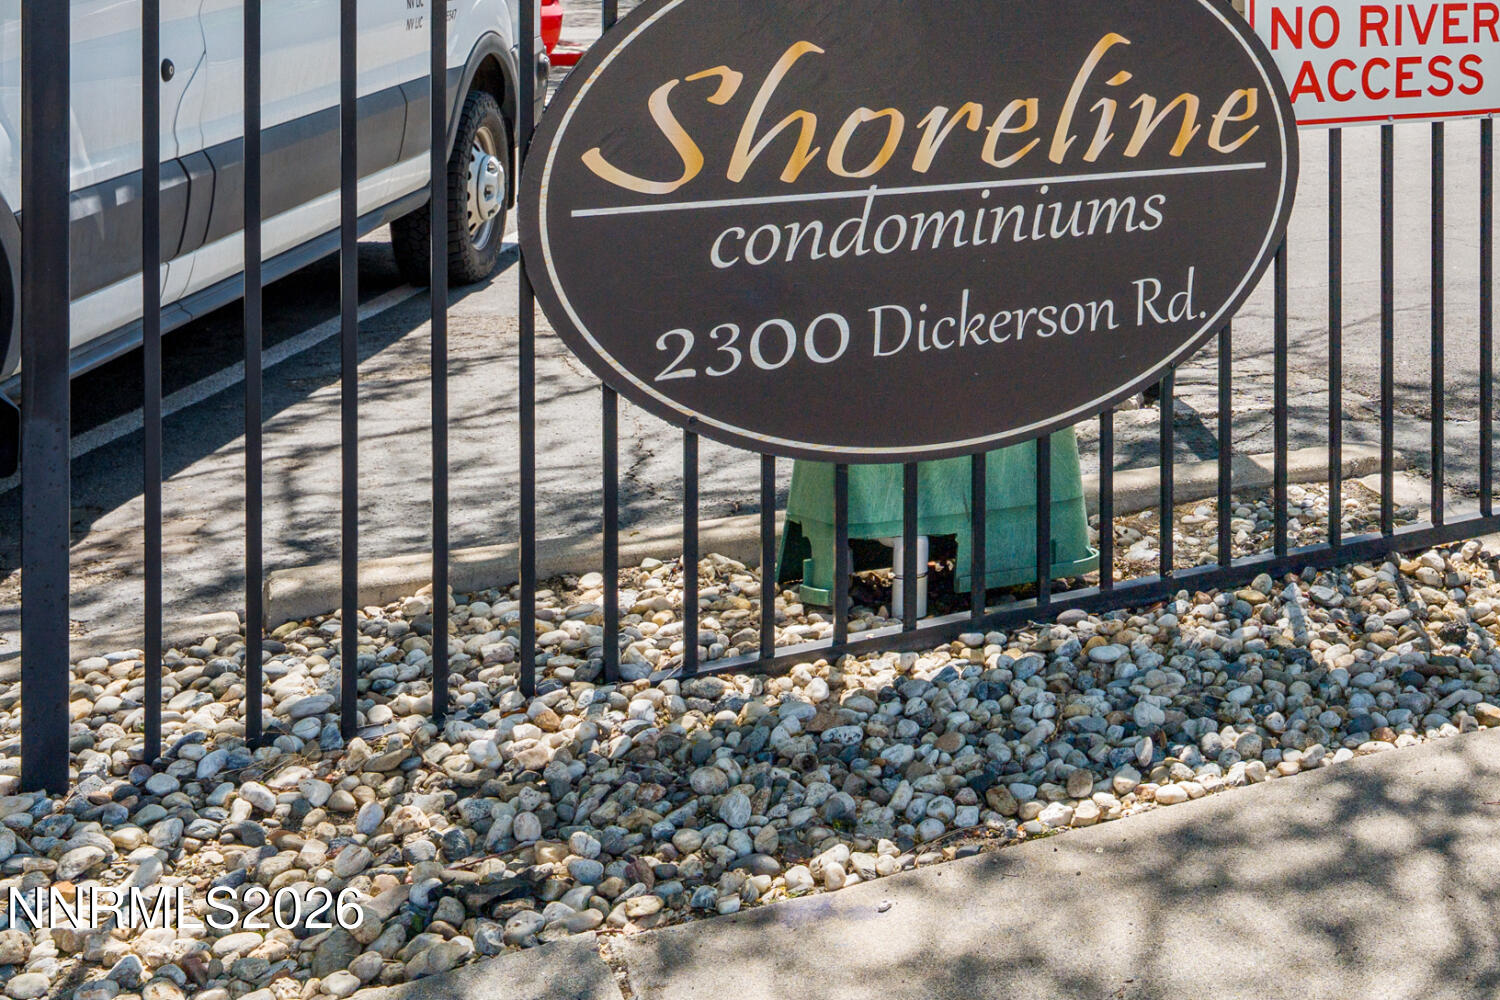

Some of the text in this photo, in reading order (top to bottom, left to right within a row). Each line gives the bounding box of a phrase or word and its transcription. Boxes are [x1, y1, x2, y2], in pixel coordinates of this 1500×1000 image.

[1271, 2, 1500, 50] NO RIVER
[581, 32, 1260, 194] Shoreline
[1290, 54, 1484, 104] ACCESS
[710, 184, 1166, 269] condominiums
[654, 266, 1207, 382] 2300 Dickerson Rd.
